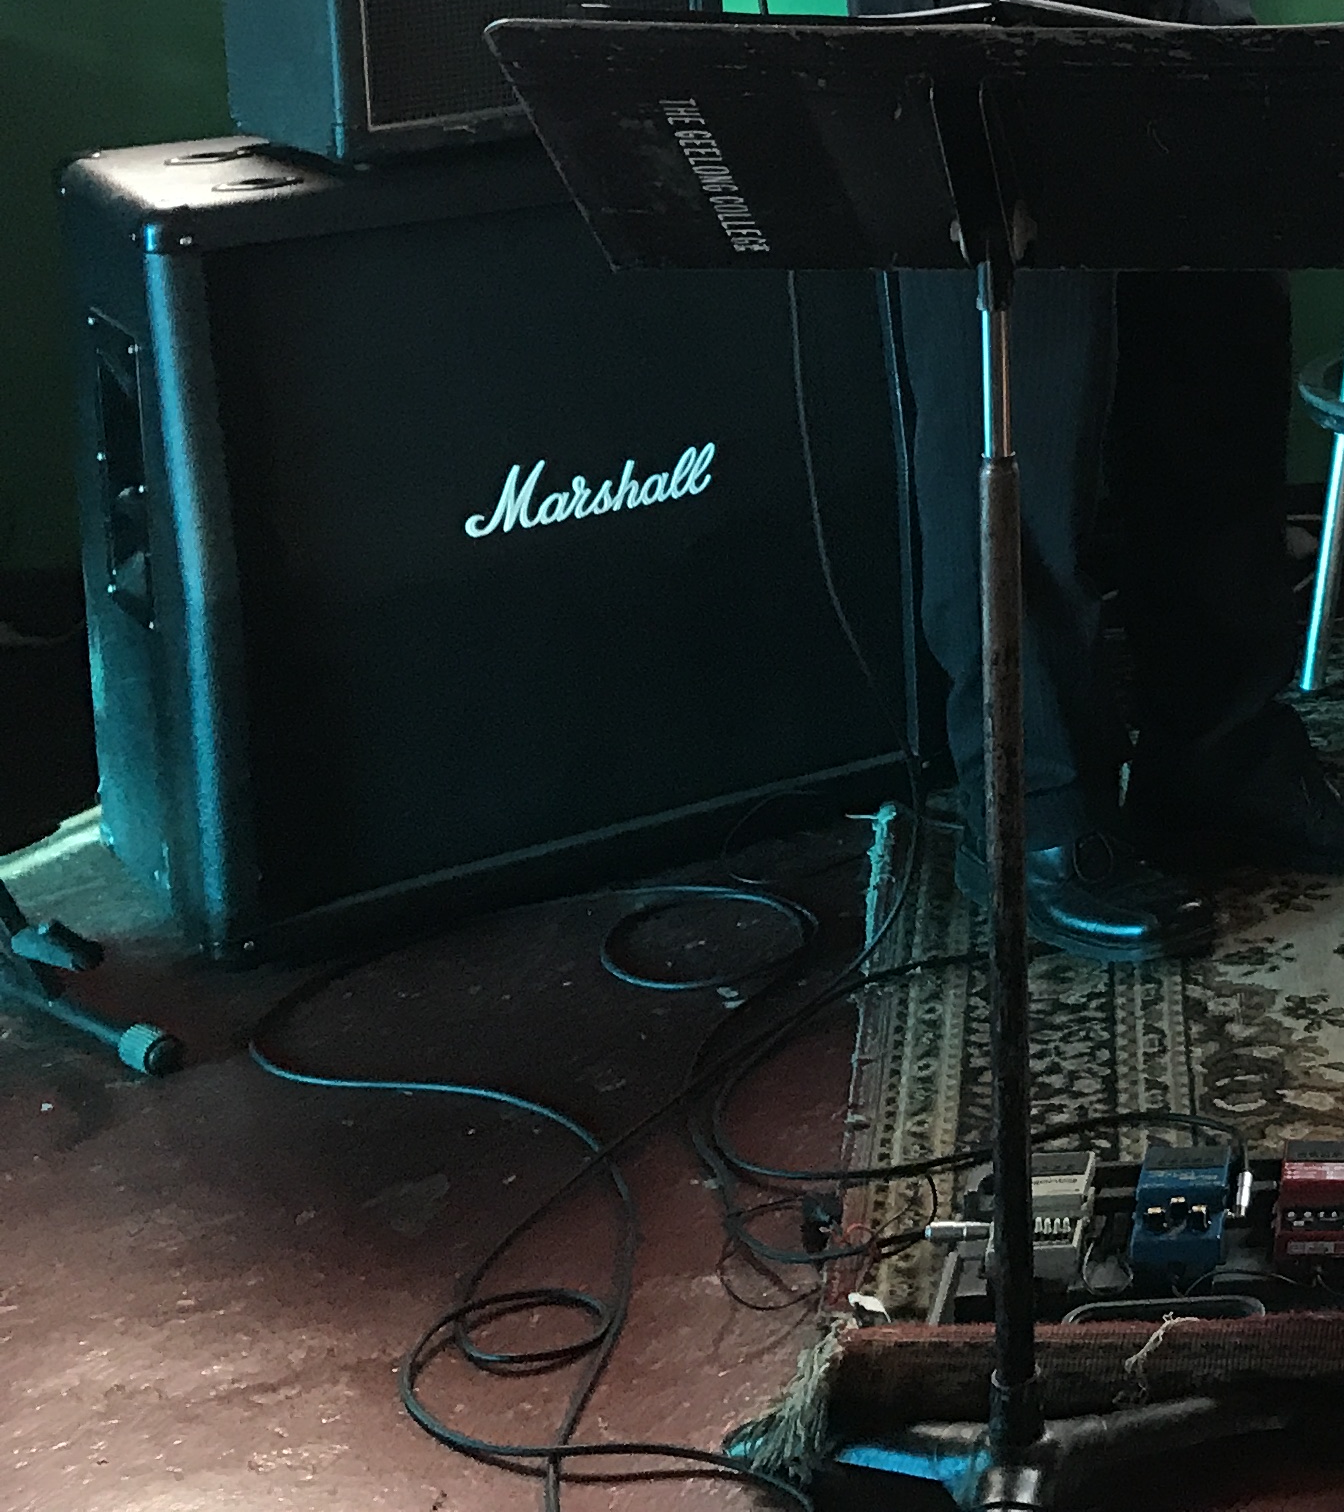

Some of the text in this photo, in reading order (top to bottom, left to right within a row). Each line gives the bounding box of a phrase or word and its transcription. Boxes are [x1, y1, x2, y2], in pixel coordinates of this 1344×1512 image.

[658, 98, 771, 252] THE GEELONG COLLEGE
[464, 442, 716, 538] Marshall
